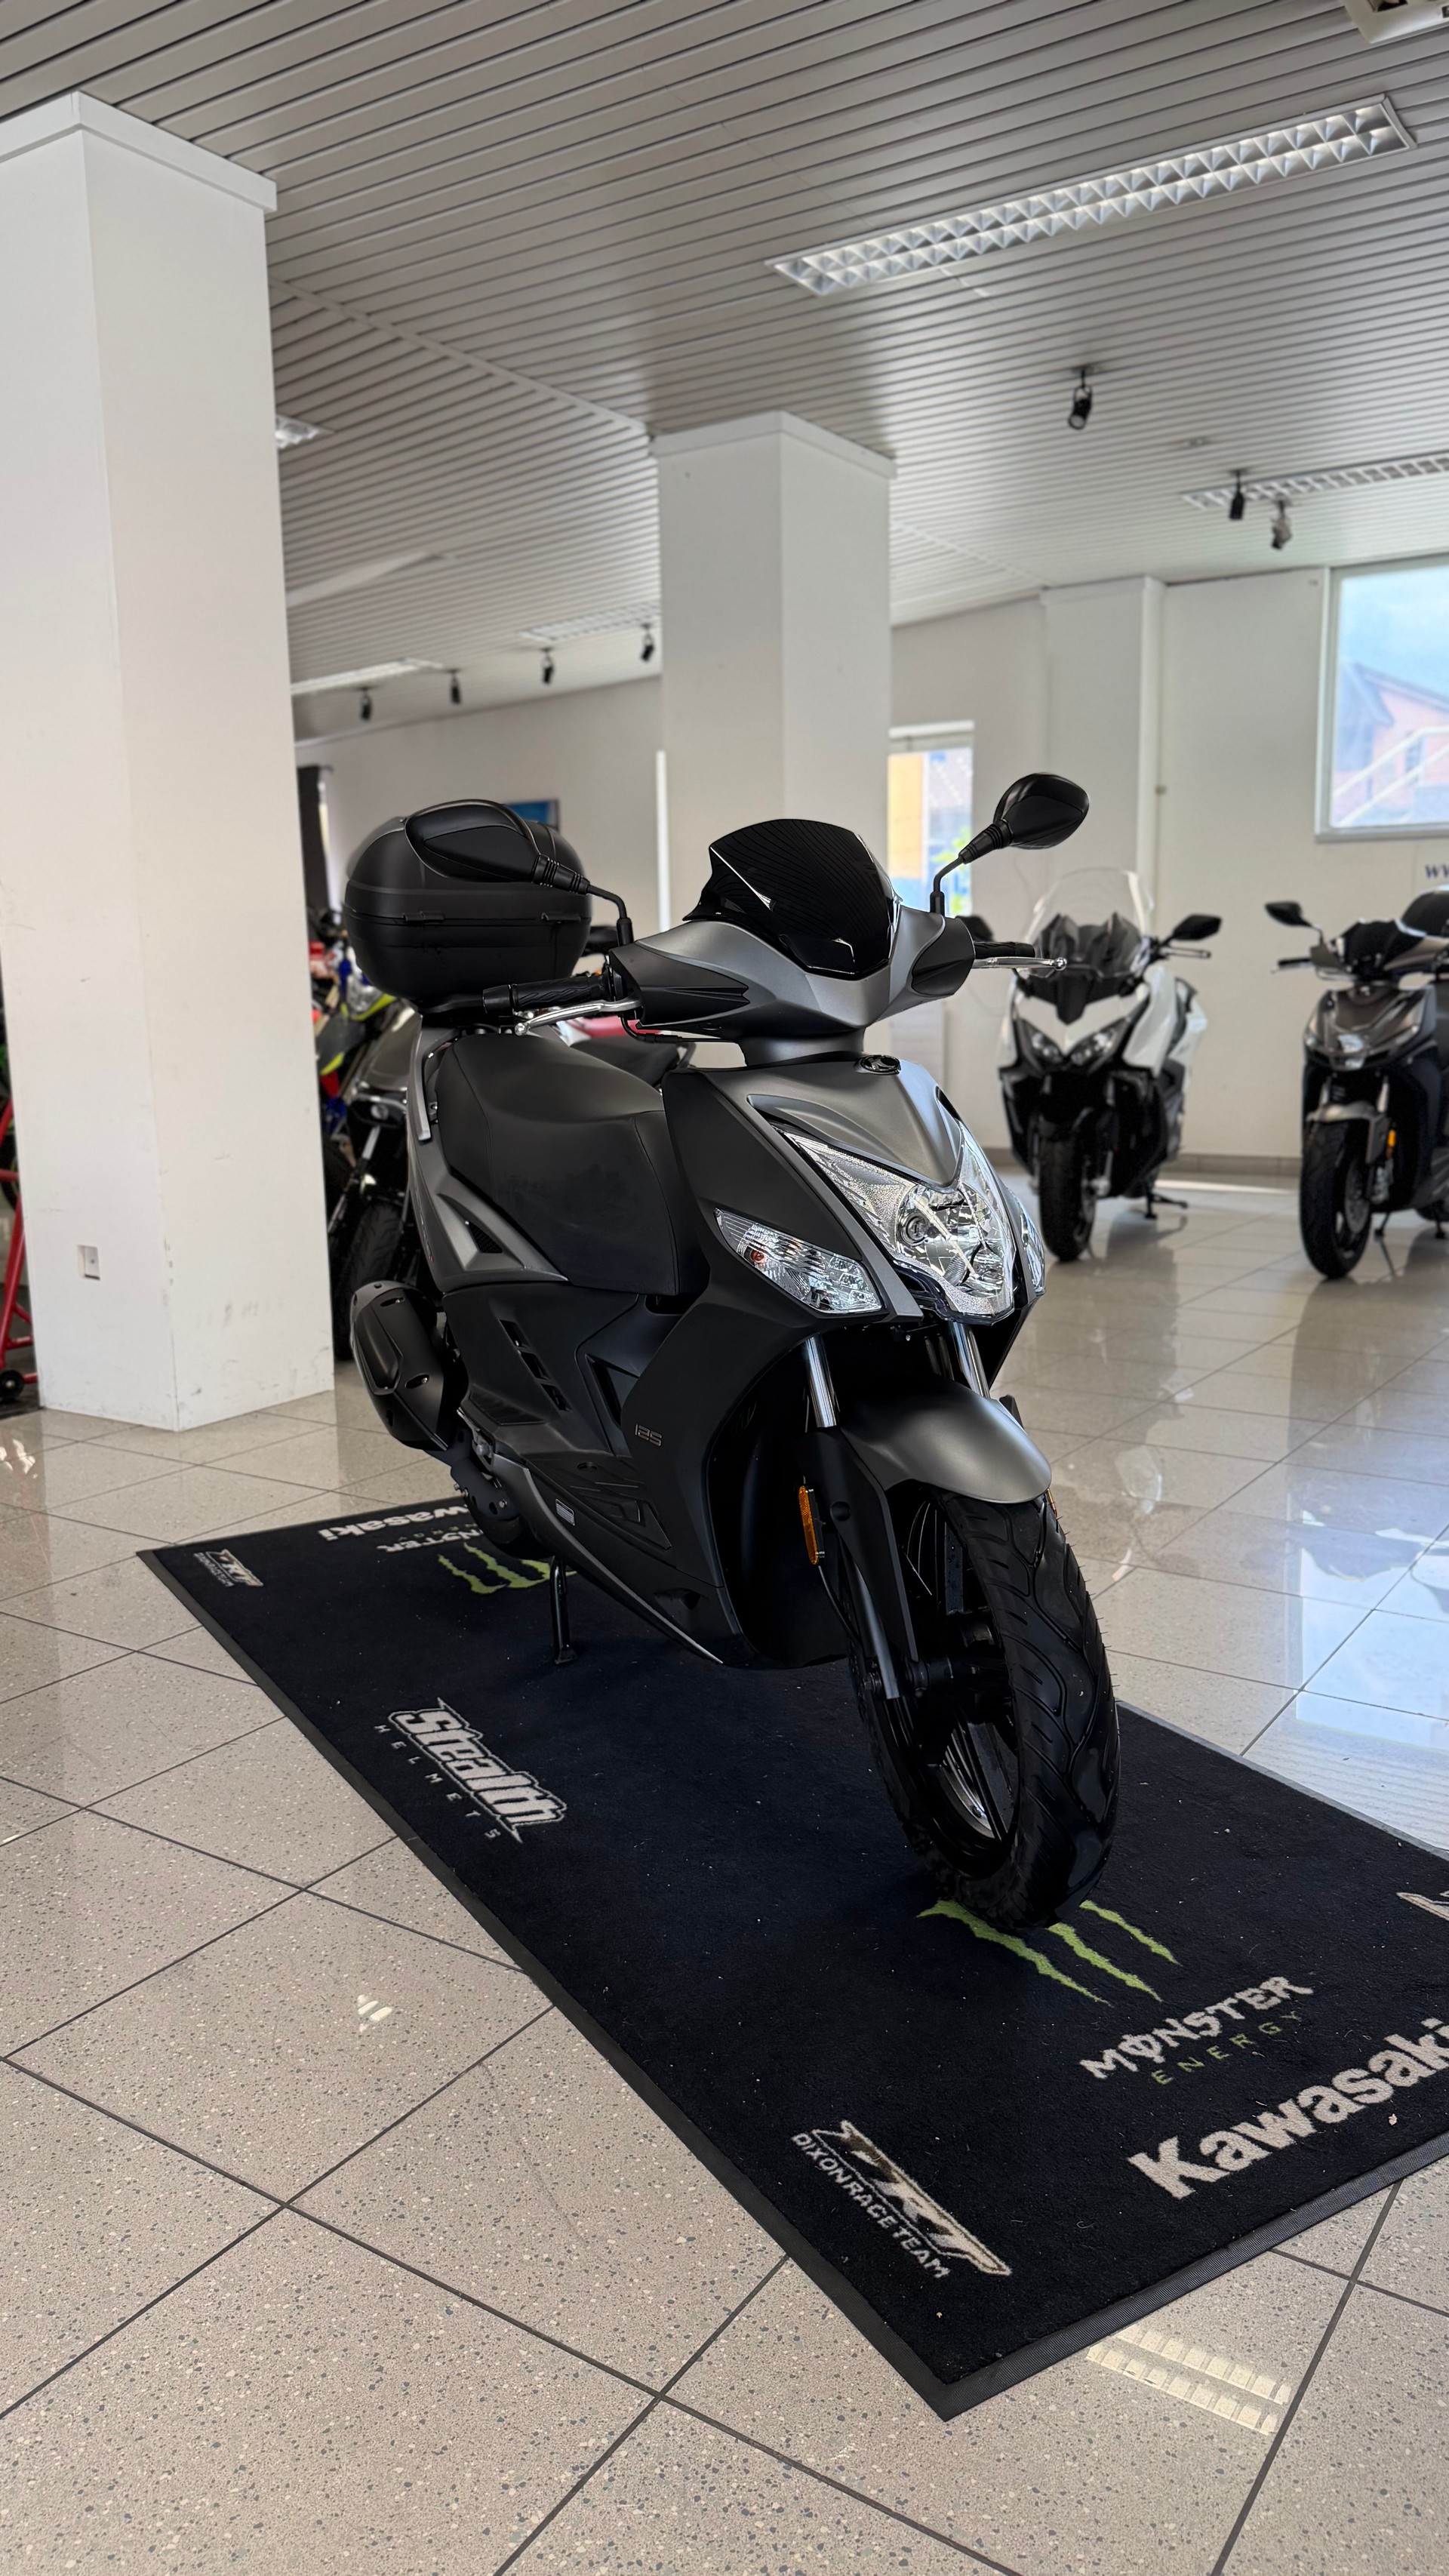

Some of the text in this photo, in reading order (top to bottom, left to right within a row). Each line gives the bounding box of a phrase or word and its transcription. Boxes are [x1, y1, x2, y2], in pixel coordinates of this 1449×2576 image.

[635, 1423, 663, 1447] 125
[318, 1504, 469, 1541] wasaki
[377, 1529, 483, 1553] NSTER
[374, 1724, 501, 1839] HELMETS
[388, 1704, 568, 1832] Stealth
[1151, 2010, 1303, 2085] ENERGY
[892, 2226, 951, 2278] TEAM
